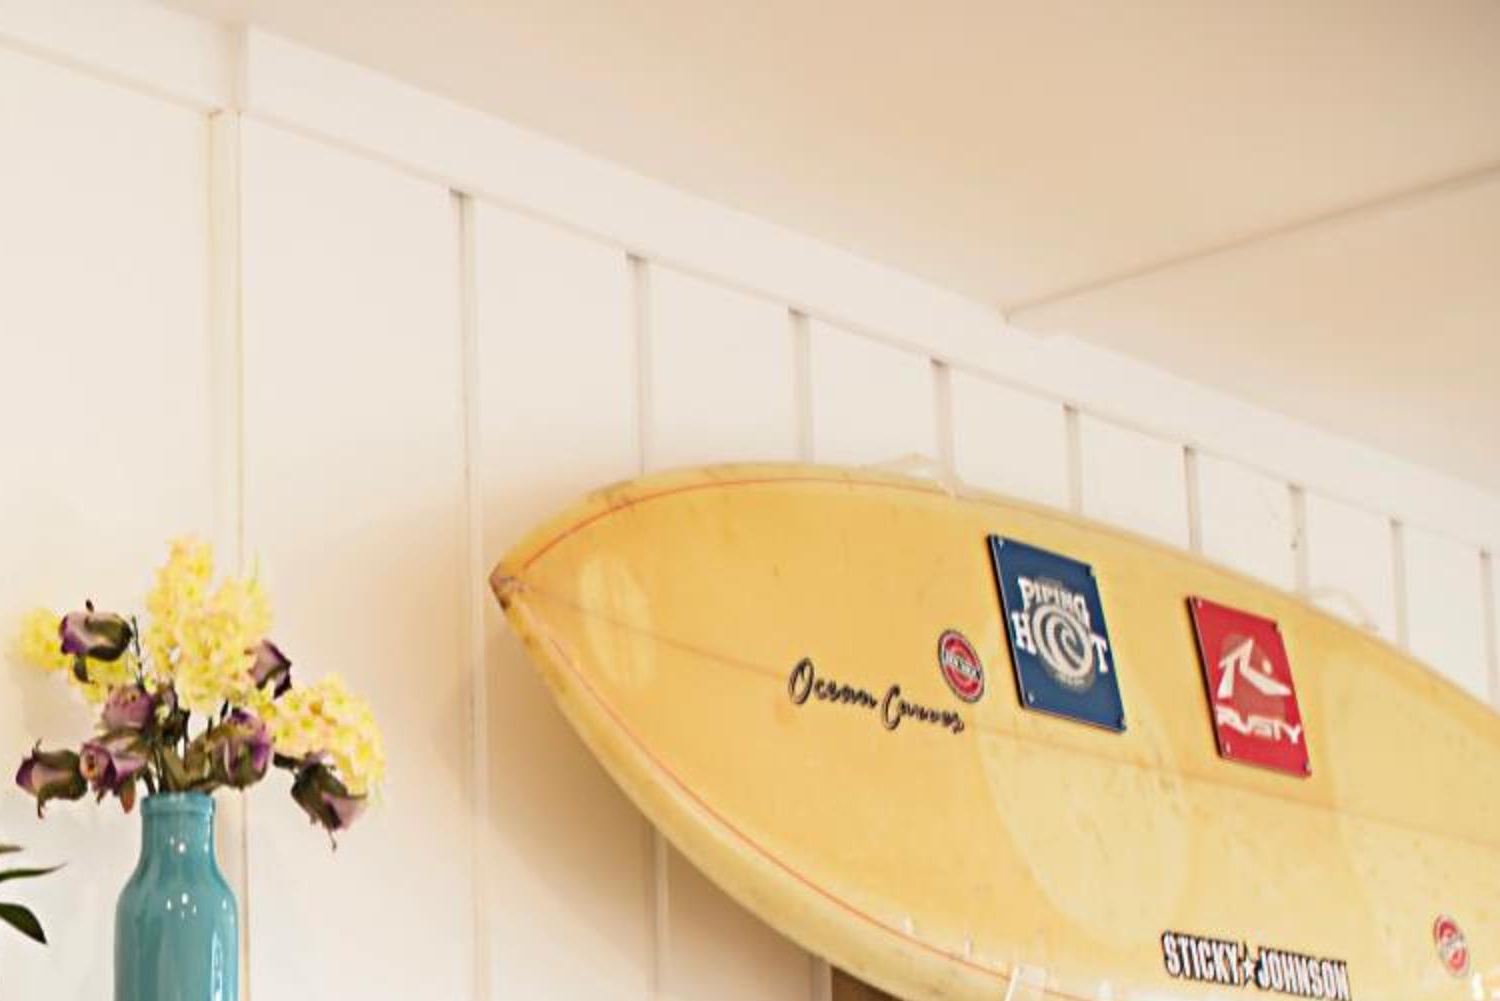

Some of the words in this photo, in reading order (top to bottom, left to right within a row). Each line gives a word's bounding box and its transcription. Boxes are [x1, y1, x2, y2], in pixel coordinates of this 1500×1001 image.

[1017, 576, 1090, 629] PIPING
[1215, 703, 1302, 744] RUSTY
[1162, 931, 1240, 986] STICKY
